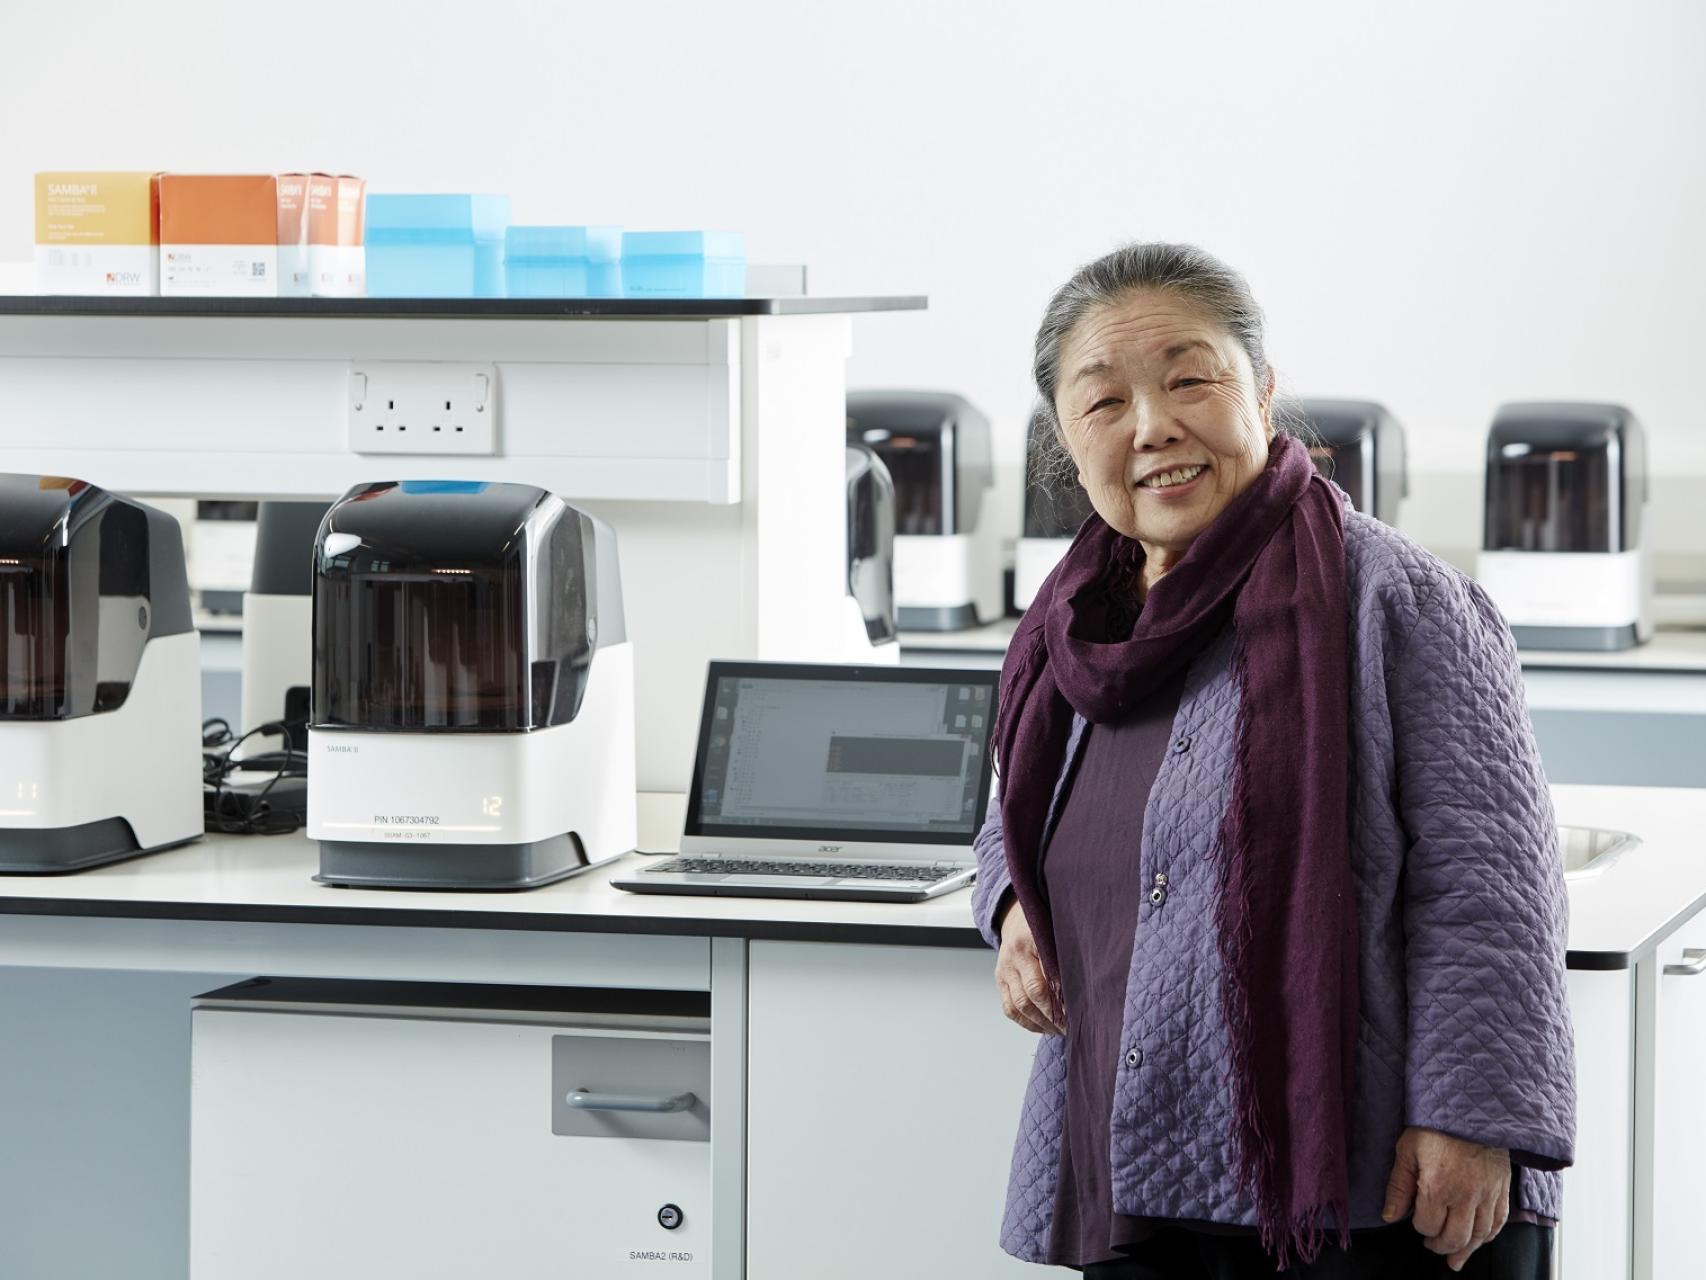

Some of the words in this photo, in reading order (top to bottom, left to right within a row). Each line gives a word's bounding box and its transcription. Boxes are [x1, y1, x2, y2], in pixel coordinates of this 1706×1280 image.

[482, 796, 502, 817] 12
[374, 815, 388, 825] PIN
[391, 816, 440, 826] 1067304792
[818, 845, 843, 853] acer
[629, 1251, 667, 1261] SAMBA2
[668, 1252, 694, 1262] (R&D)
